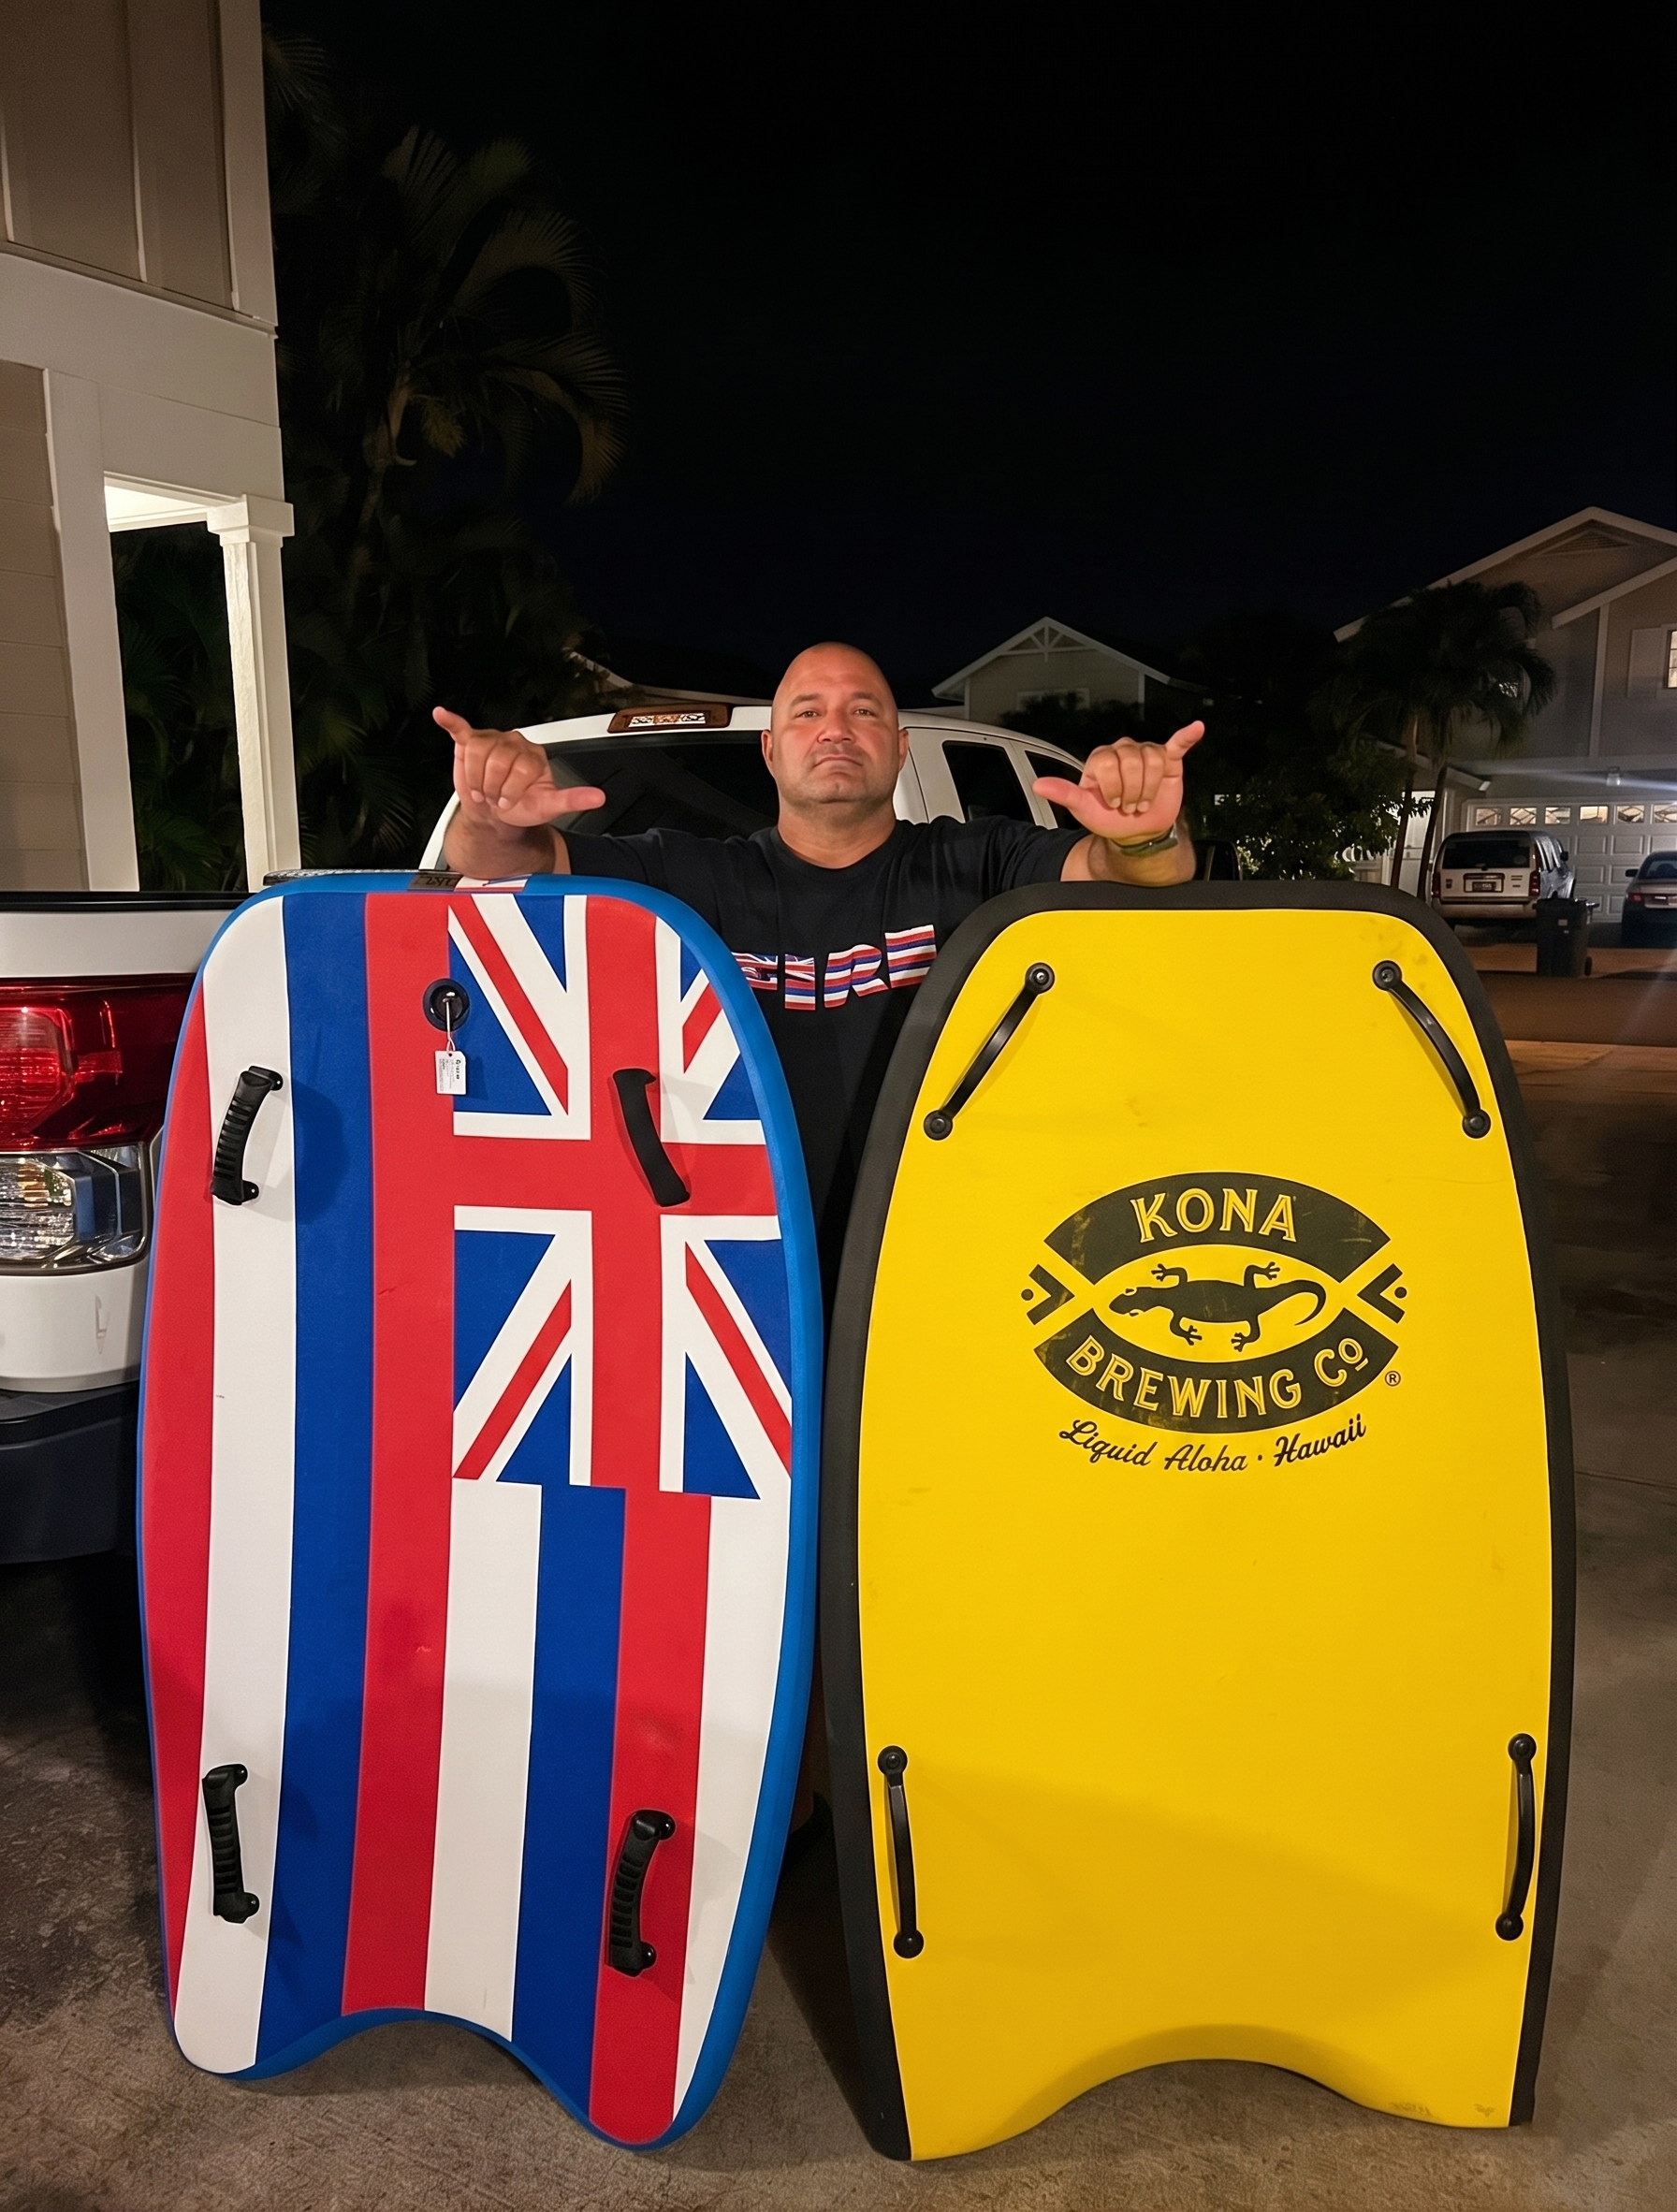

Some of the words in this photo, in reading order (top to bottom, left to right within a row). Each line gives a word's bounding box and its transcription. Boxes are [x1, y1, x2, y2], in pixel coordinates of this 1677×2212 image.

[1130, 1187, 1296, 1243] KONA
[1065, 1334, 1302, 1419] BREWING
[1059, 1419, 1158, 1467] Liquid
[1163, 1441, 1247, 1472] Aloha
[1274, 1413, 1367, 1467] Hawaii
